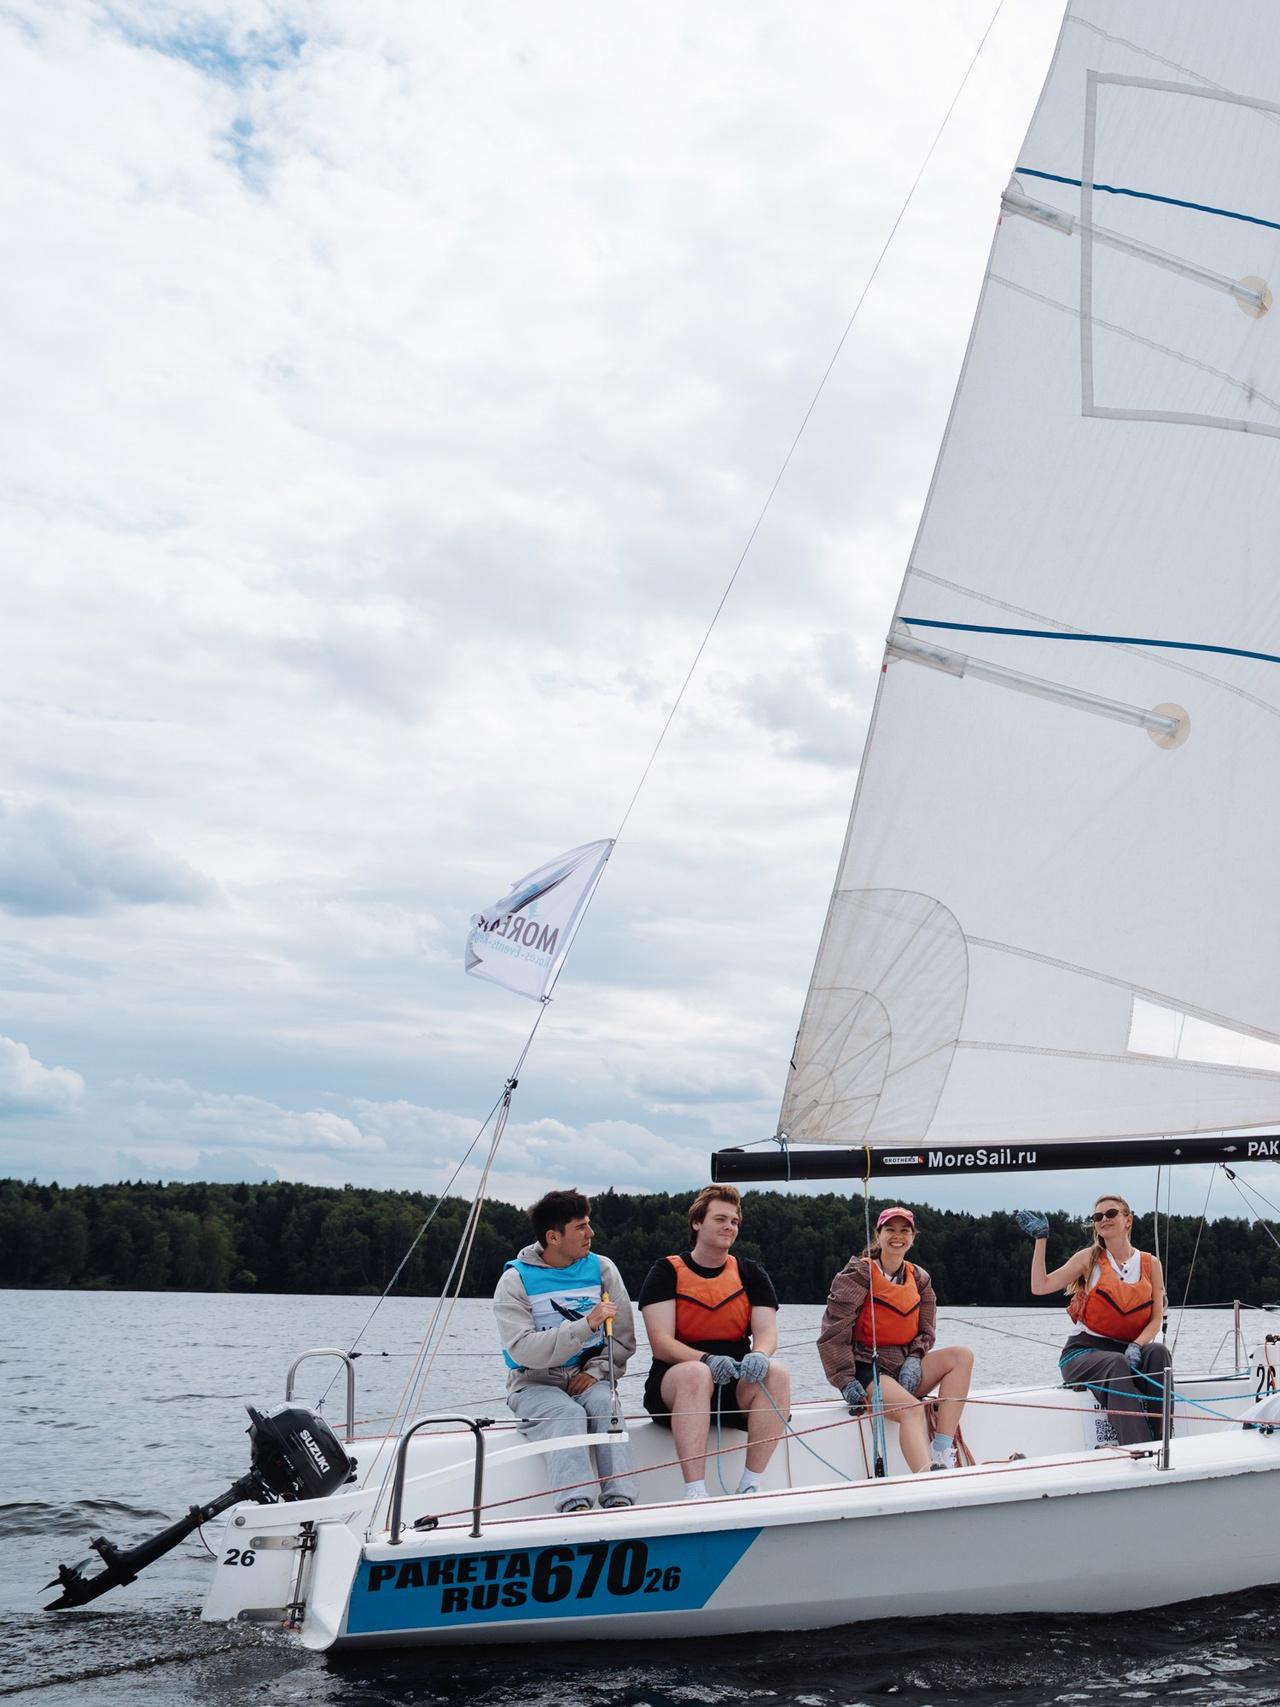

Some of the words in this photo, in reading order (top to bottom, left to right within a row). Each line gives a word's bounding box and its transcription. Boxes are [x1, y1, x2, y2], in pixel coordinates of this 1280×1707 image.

[928, 1149, 1036, 1167] MoreSail.ru
[300, 1429, 331, 1473] SUZUKI
[223, 1548, 256, 1566] 26
[531, 1540, 648, 1604] 670
[643, 1566, 681, 1594] 26
[440, 1581, 528, 1613] RUS
